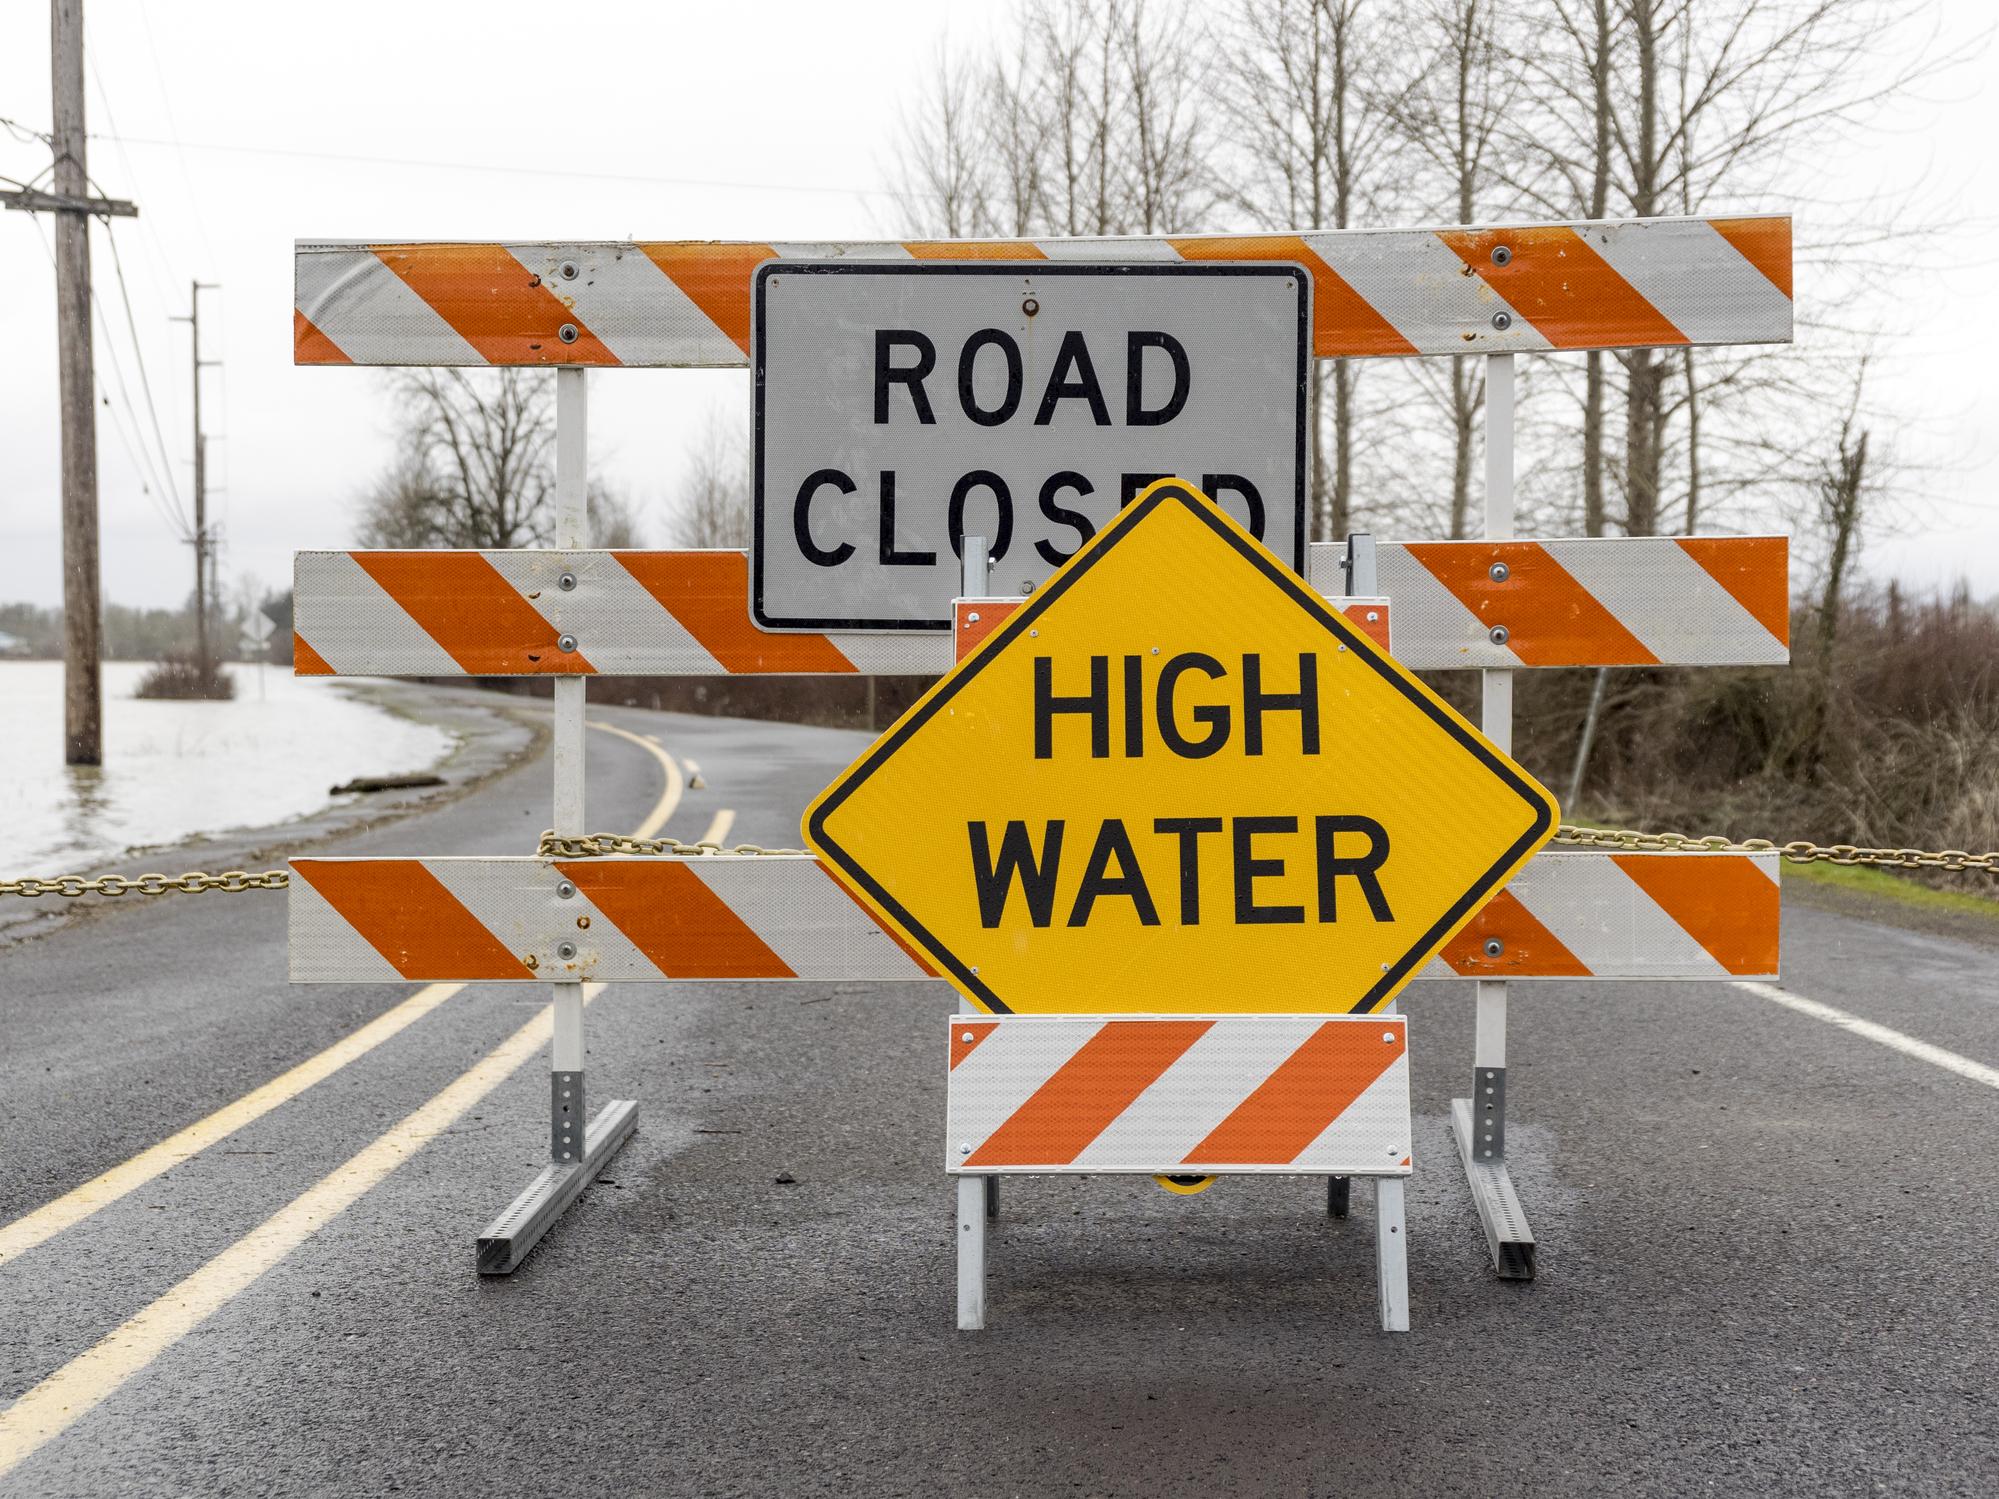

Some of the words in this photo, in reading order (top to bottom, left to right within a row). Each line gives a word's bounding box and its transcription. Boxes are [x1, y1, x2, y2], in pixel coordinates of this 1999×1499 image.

[874, 328, 1190, 427] ROAD
[793, 469, 1265, 568] CLOS
[1034, 652, 1320, 759] HIGH
[968, 815, 1395, 928] WATER
